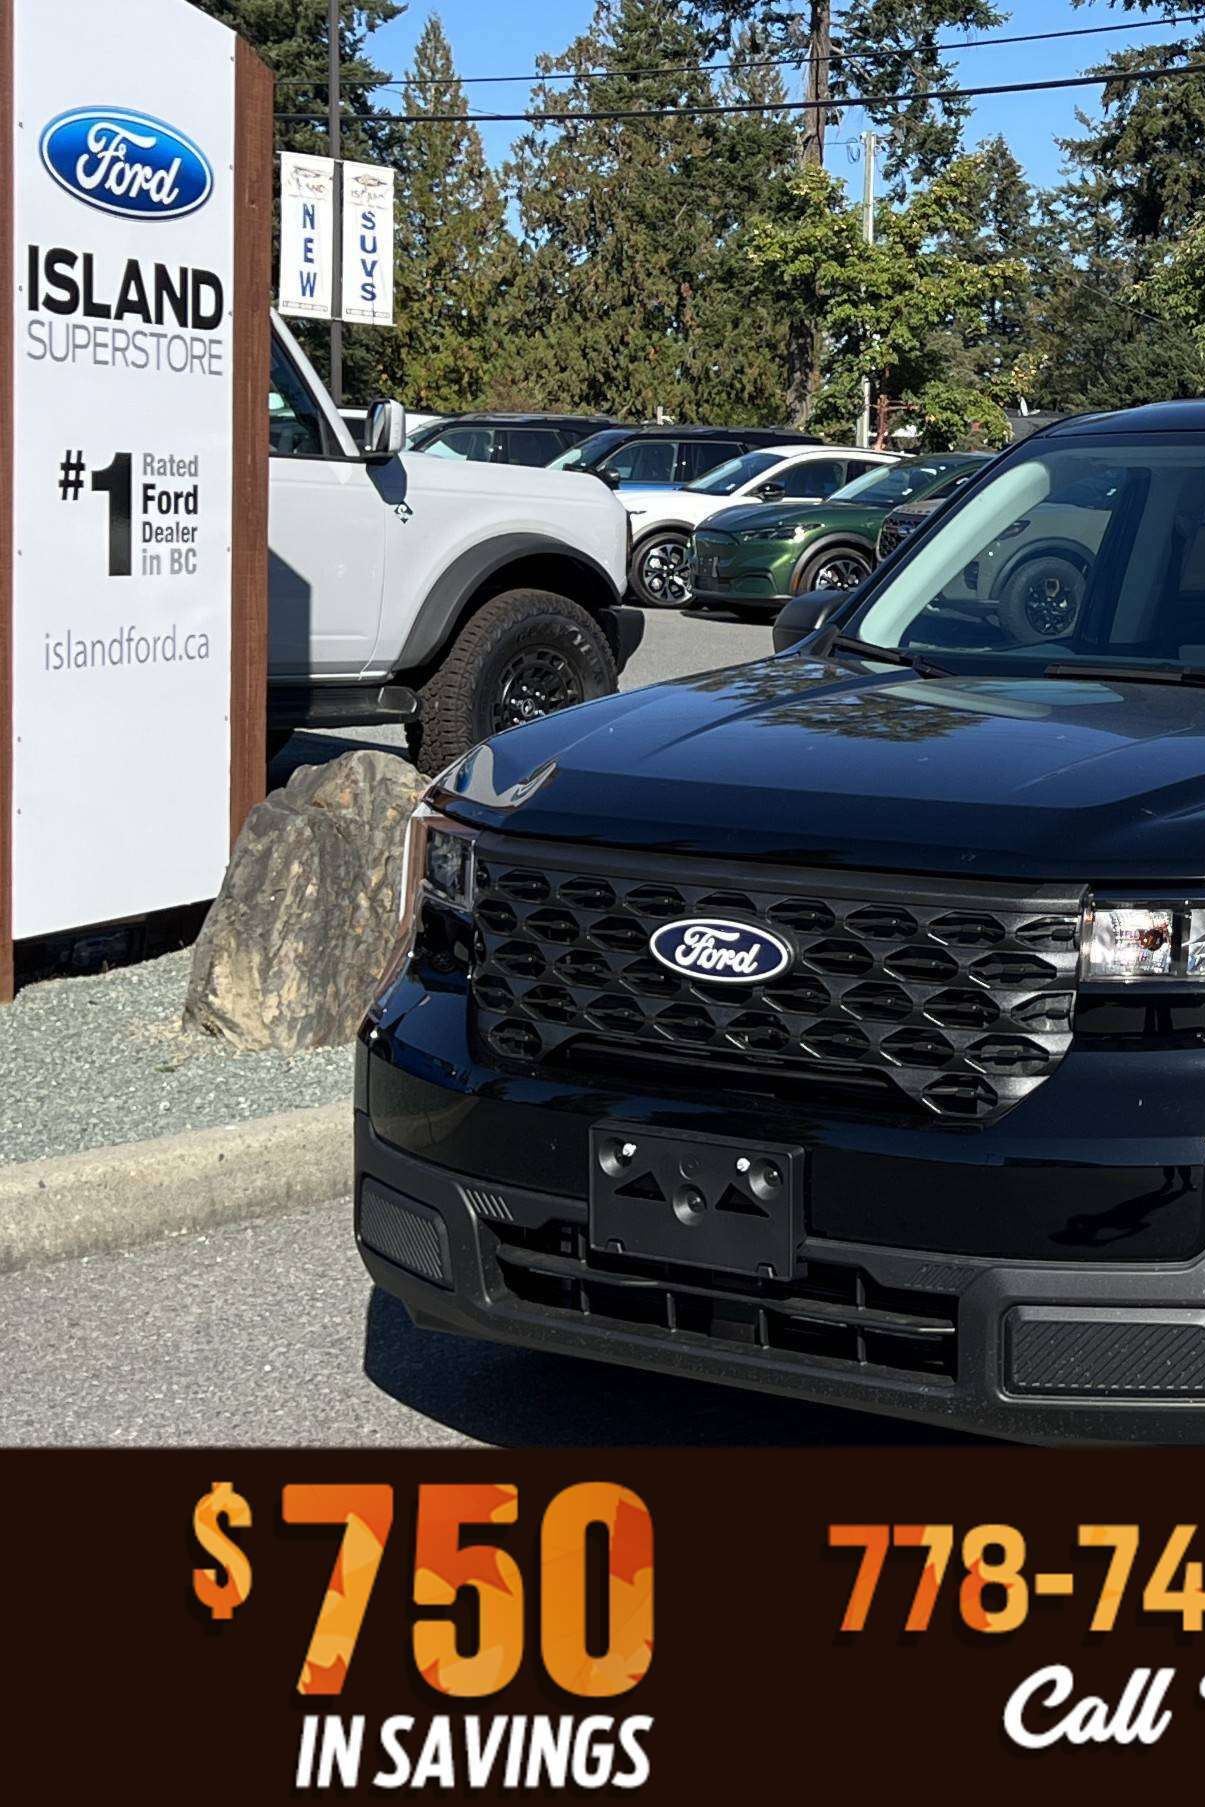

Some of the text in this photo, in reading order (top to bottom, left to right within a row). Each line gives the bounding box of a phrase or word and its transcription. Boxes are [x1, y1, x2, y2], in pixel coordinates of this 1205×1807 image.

[76, 121, 182, 206] Ford
[27, 244, 224, 331] ISLAND
[26, 318, 224, 377] SUPERSTORE
[142, 452, 199, 478] Rated
[142, 483, 199, 515] Ford
[141, 520, 199, 544] Dealer
[141, 548, 198, 576] in BC
[44, 623, 210, 671] islandford.ca
[674, 925, 761, 974] Ford
